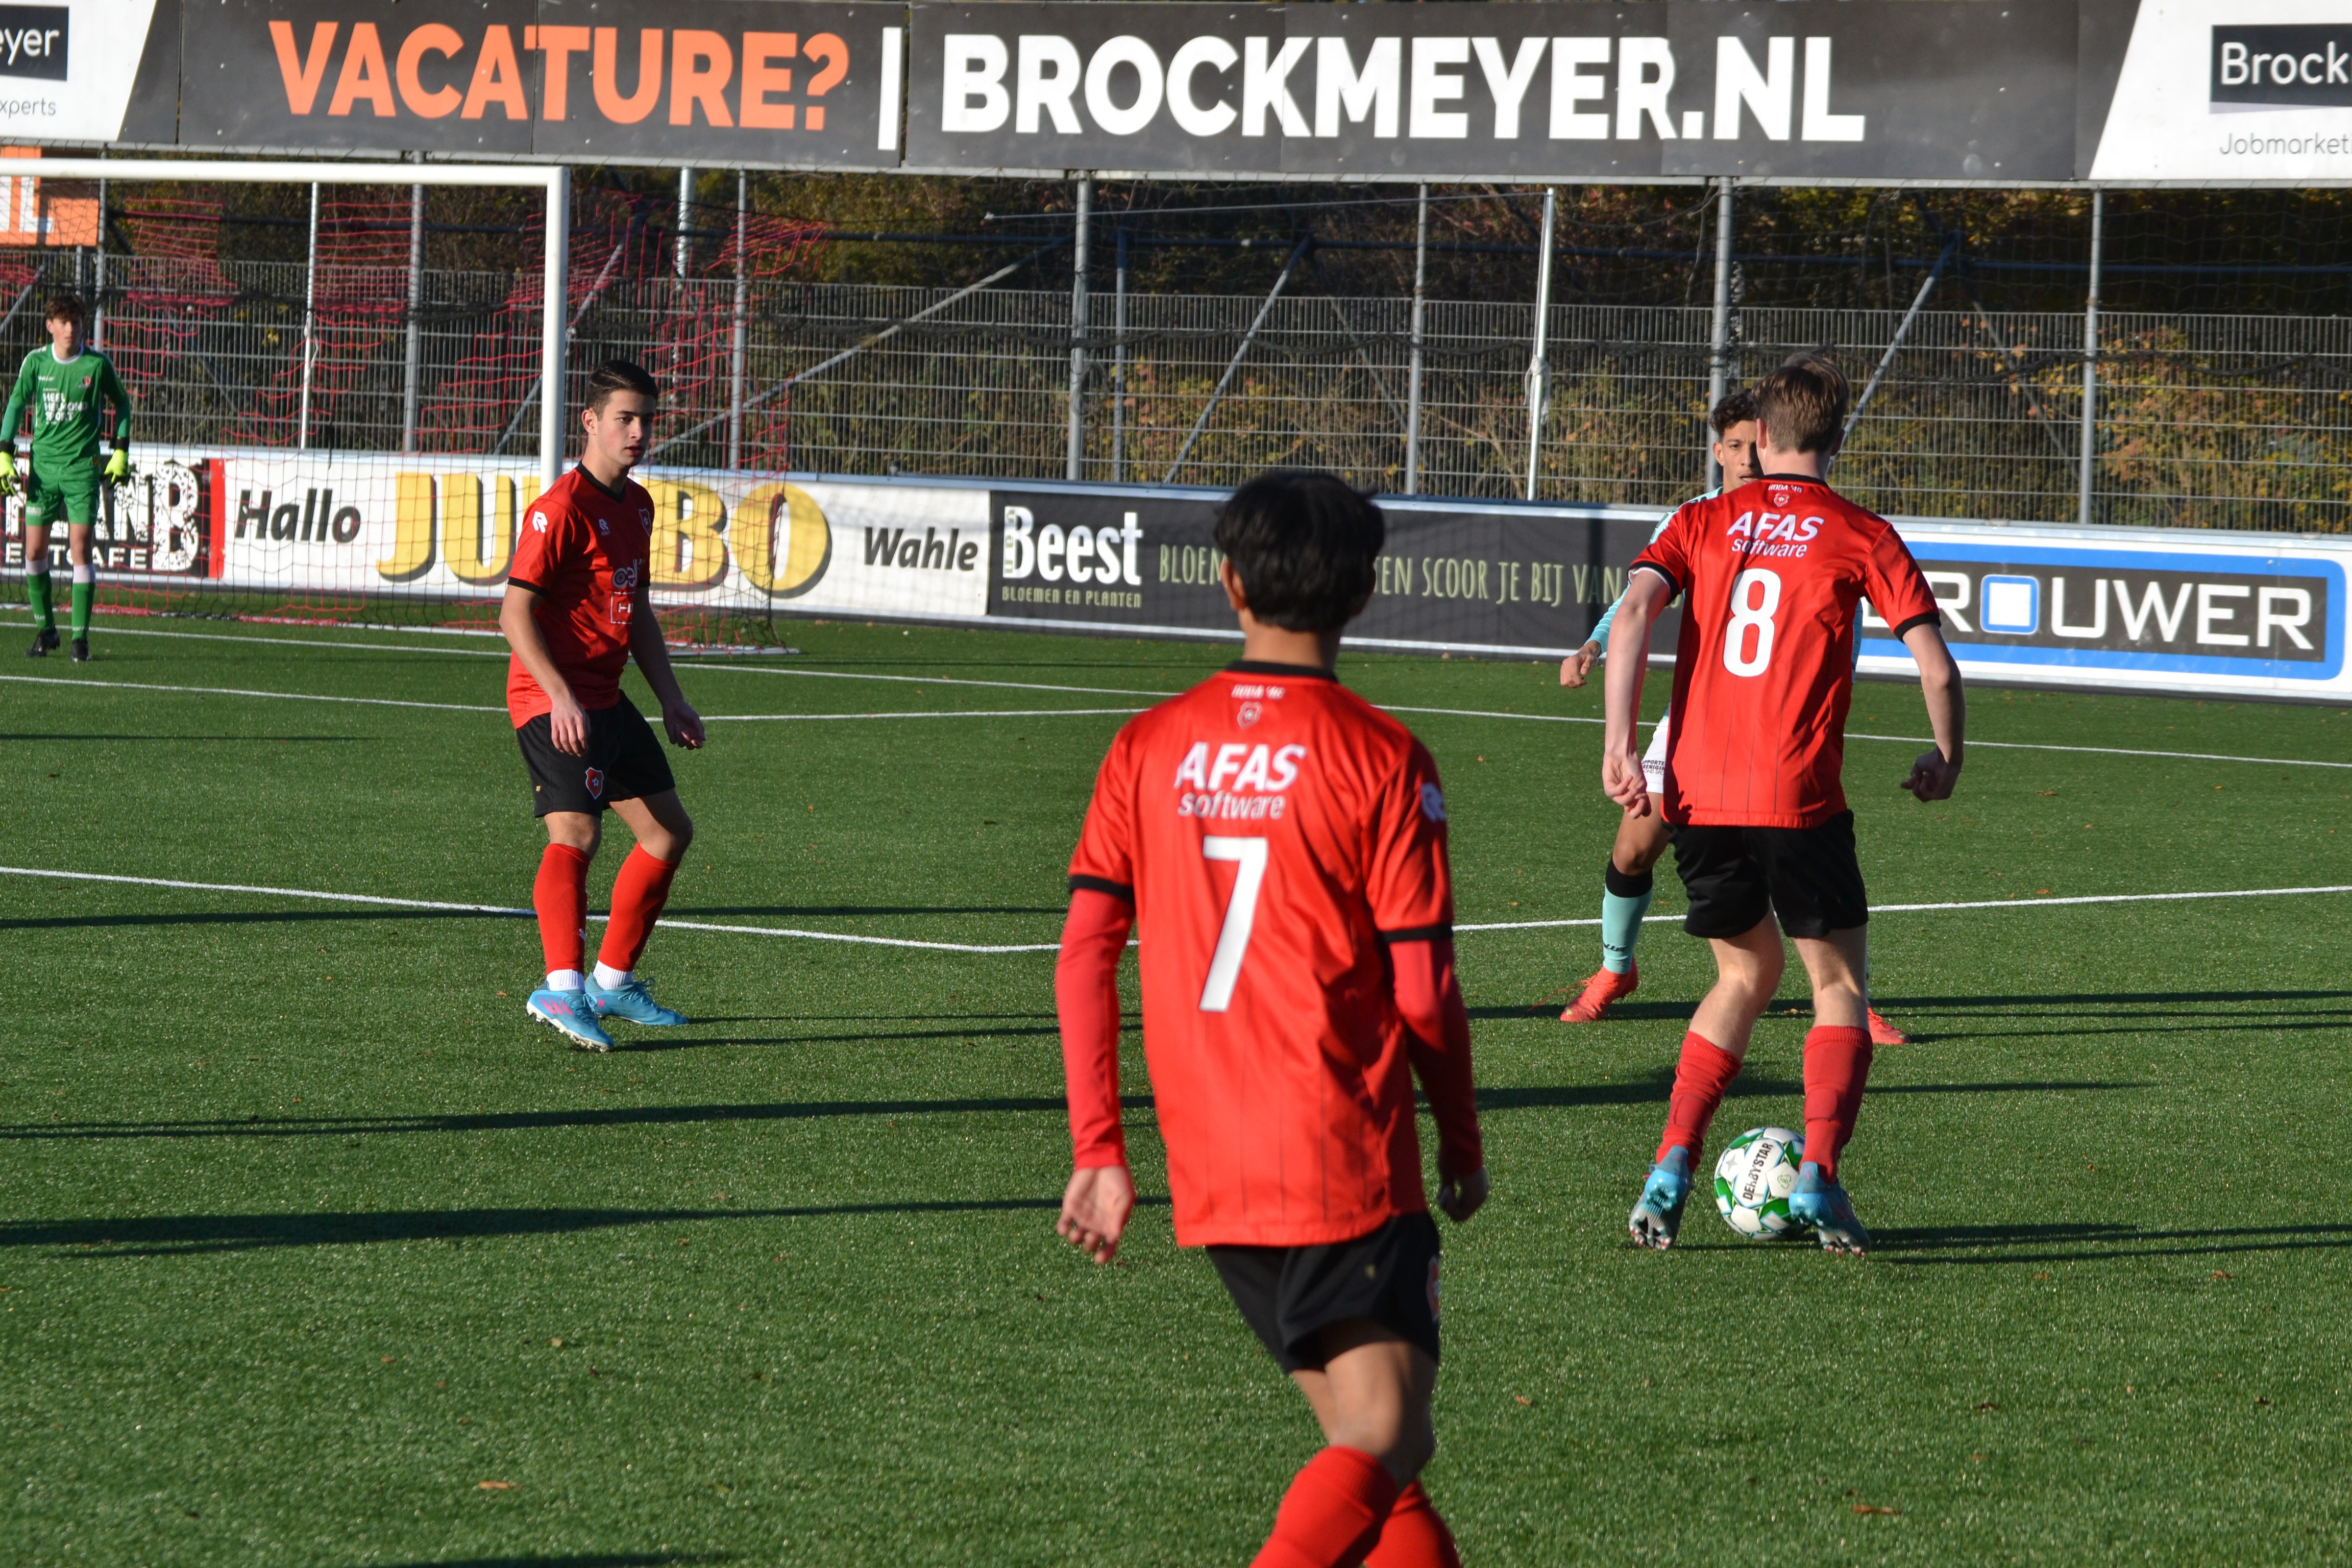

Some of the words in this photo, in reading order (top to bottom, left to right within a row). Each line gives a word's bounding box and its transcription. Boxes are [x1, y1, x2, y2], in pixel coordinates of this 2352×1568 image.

[0, 28, 60, 66] yer
[2221, 41, 2352, 85] Brock
[268, 21, 849, 130] VACATURE?
[941, 34, 1866, 142] BROCKMEYER.NL
[235, 488, 361, 544] Hallo
[376, 472, 831, 597] JUBO
[864, 526, 978, 571] Wahle
[1002, 506, 1143, 585] Beest
[1726, 511, 1825, 542] AFAS
[1731, 538, 1807, 558] software
[1002, 586, 1060, 603] BLOEMEN
[1065, 590, 1081, 605] EN
[1086, 590, 1142, 608] PLANTEN
[1422, 557, 1489, 599] SCOOR
[1496, 561, 1521, 604] JE
[1531, 562, 1564, 607] BIJ
[1573, 563, 1622, 605] VAN
[1723, 568, 1781, 678] 8
[1173, 741, 1307, 791] AFAS
[1178, 790, 1286, 820] software
[1199, 835, 1269, 1012] 7
